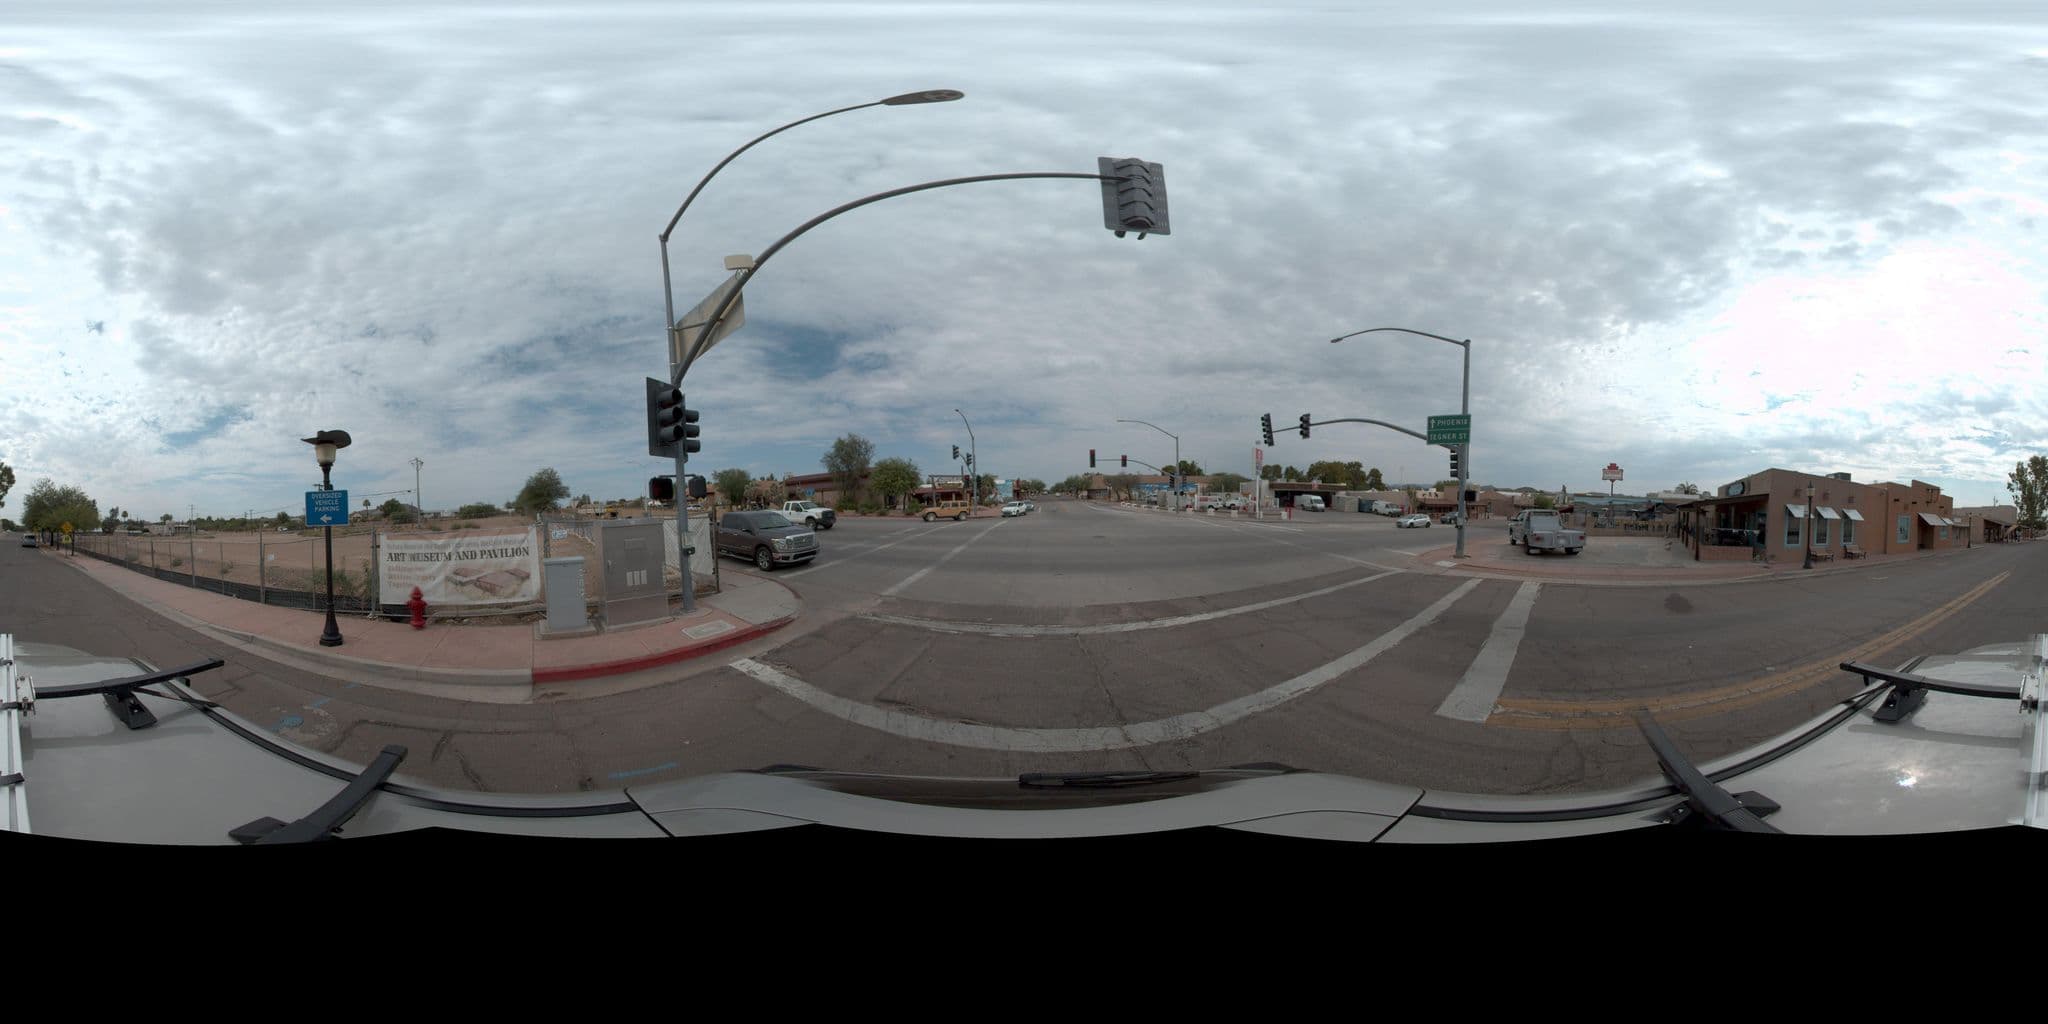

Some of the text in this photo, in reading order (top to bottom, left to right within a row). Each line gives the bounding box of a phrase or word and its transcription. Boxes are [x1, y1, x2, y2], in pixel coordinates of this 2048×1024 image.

[386, 546, 530, 562] ART MUSEUM AND PAVILION
